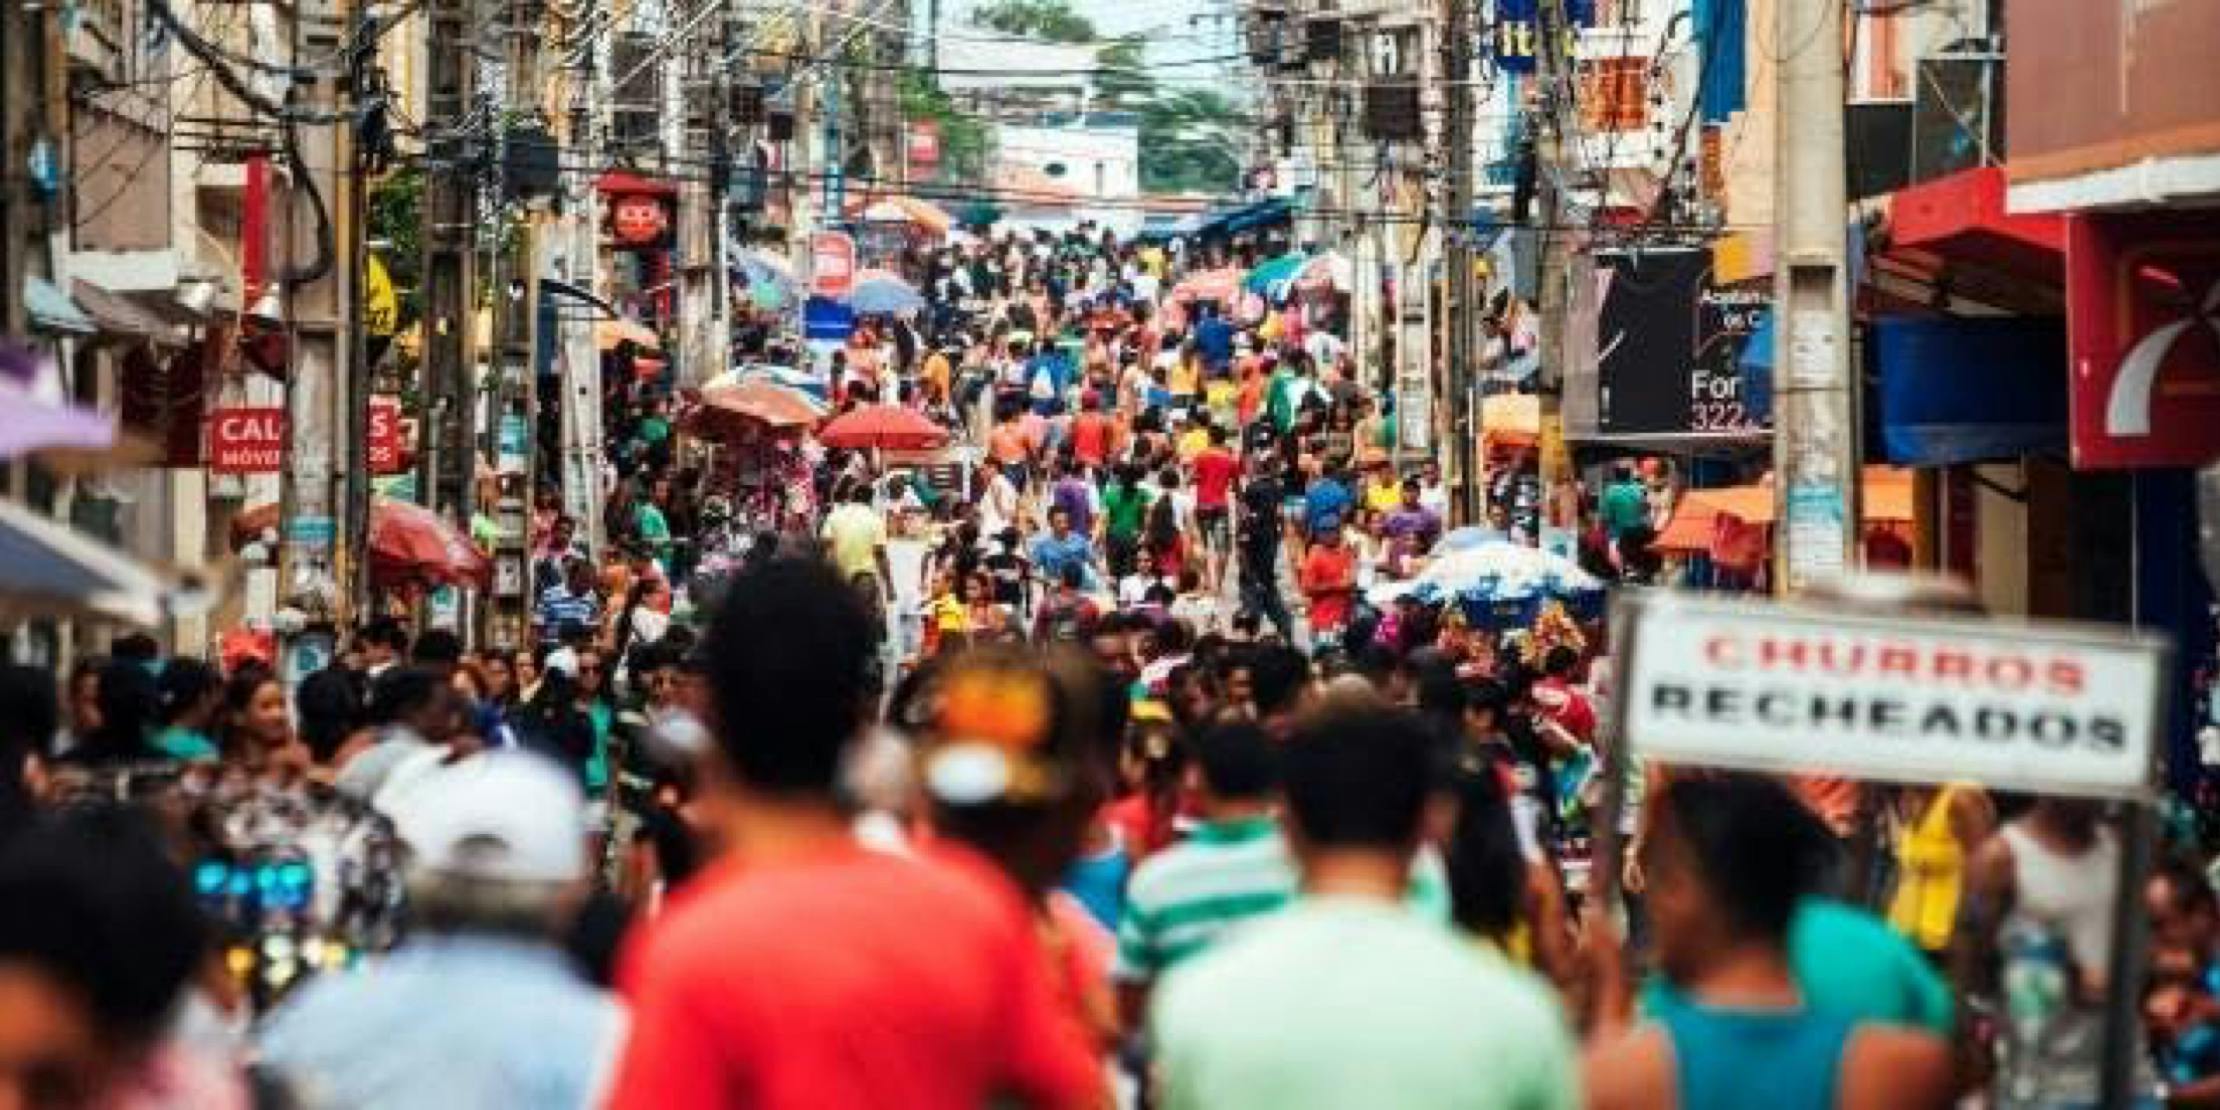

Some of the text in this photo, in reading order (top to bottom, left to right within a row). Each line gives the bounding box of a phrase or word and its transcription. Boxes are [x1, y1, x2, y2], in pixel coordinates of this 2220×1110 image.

[1691, 369, 1744, 399] For
[1704, 634, 2089, 695] CHURROS
[1650, 682, 2130, 749] RECHEADOS
